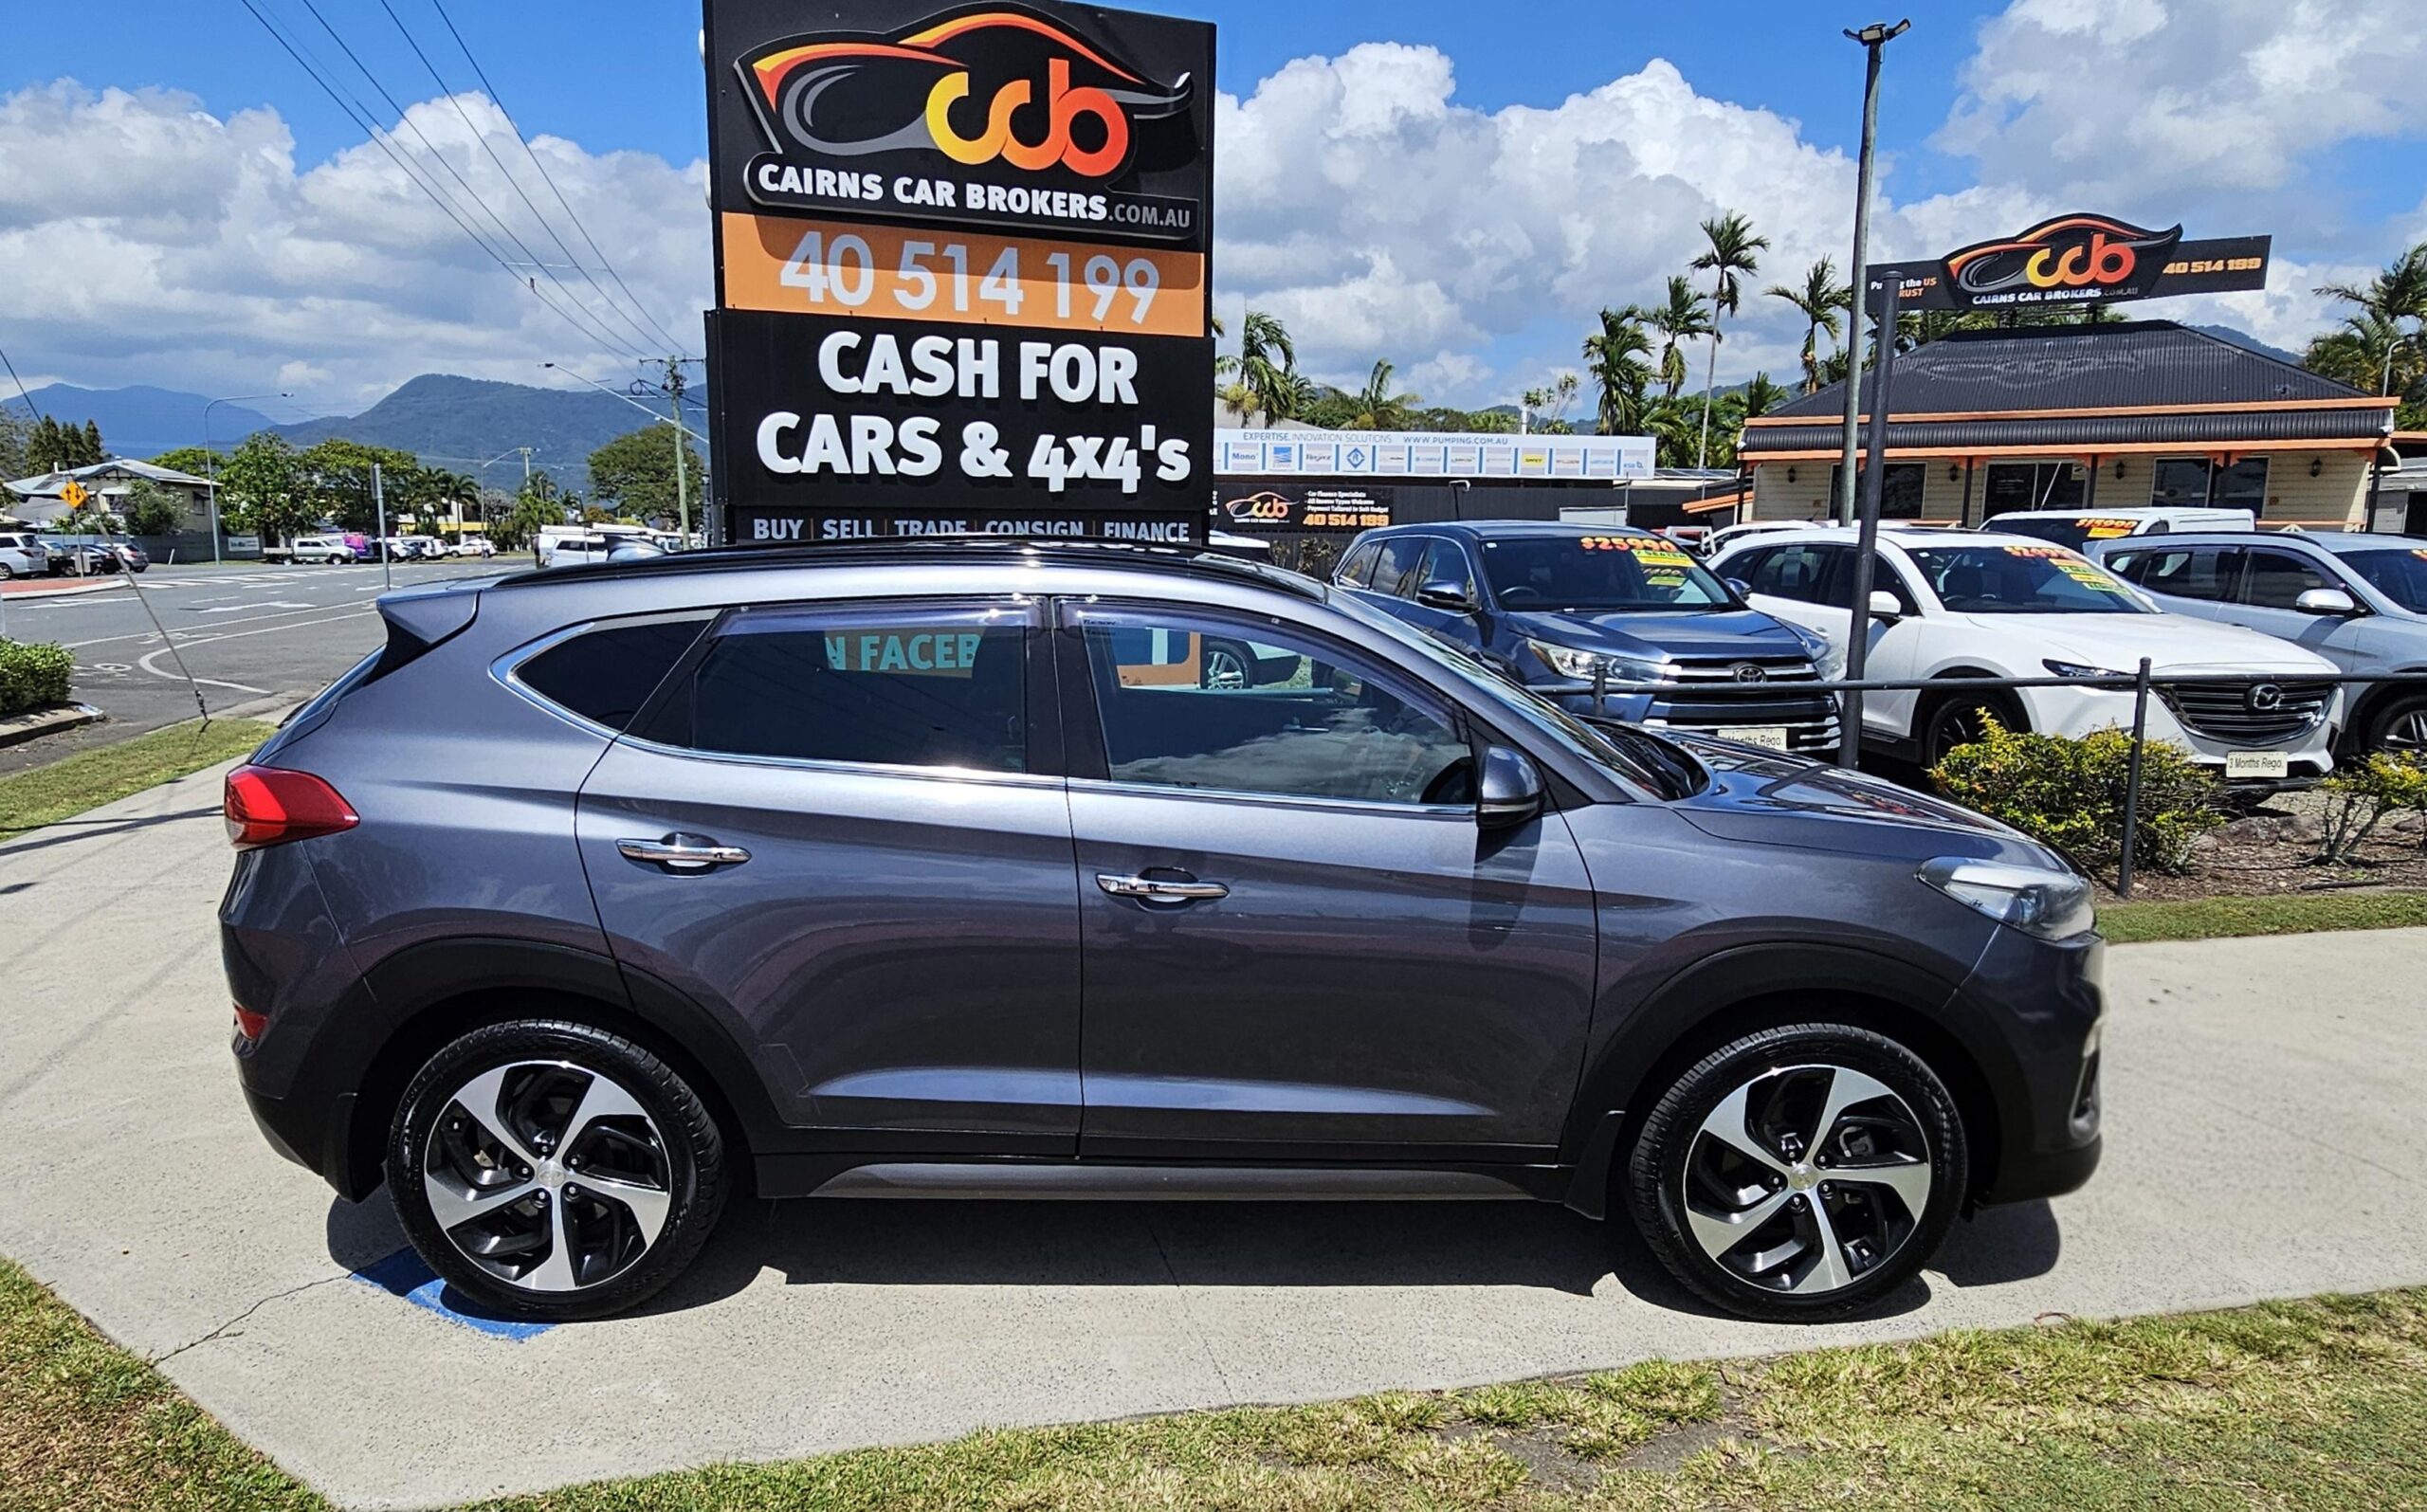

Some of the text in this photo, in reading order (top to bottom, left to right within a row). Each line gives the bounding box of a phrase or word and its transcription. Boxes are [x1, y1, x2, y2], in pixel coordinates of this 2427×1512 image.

[758, 164, 883, 201] CAIRNS
[893, 177, 956, 208] CAR
[2162, 257, 2262, 274] 40 514 199
[779, 231, 1159, 323] 40 514 199
[1906, 279, 1922, 287] the
[1924, 277, 1937, 286] US
[1899, 287, 1924, 298] RUST
[1972, 293, 2016, 305] CAIRNS
[2017, 291, 2041, 302] CAR
[818, 331, 1139, 405] CASH FOR
[756, 410, 942, 477] CARS
[959, 421, 1013, 478] &
[1303, 513, 1389, 526] 40 514 199
[754, 519, 1190, 542] BUY SELL TRADE CONSIGN FINANCE
[1580, 537, 1678, 552] $25990
[861, 633, 981, 670] FACEB
[2229, 757, 2234, 769] 3
[2235, 756, 2260, 769] Months
